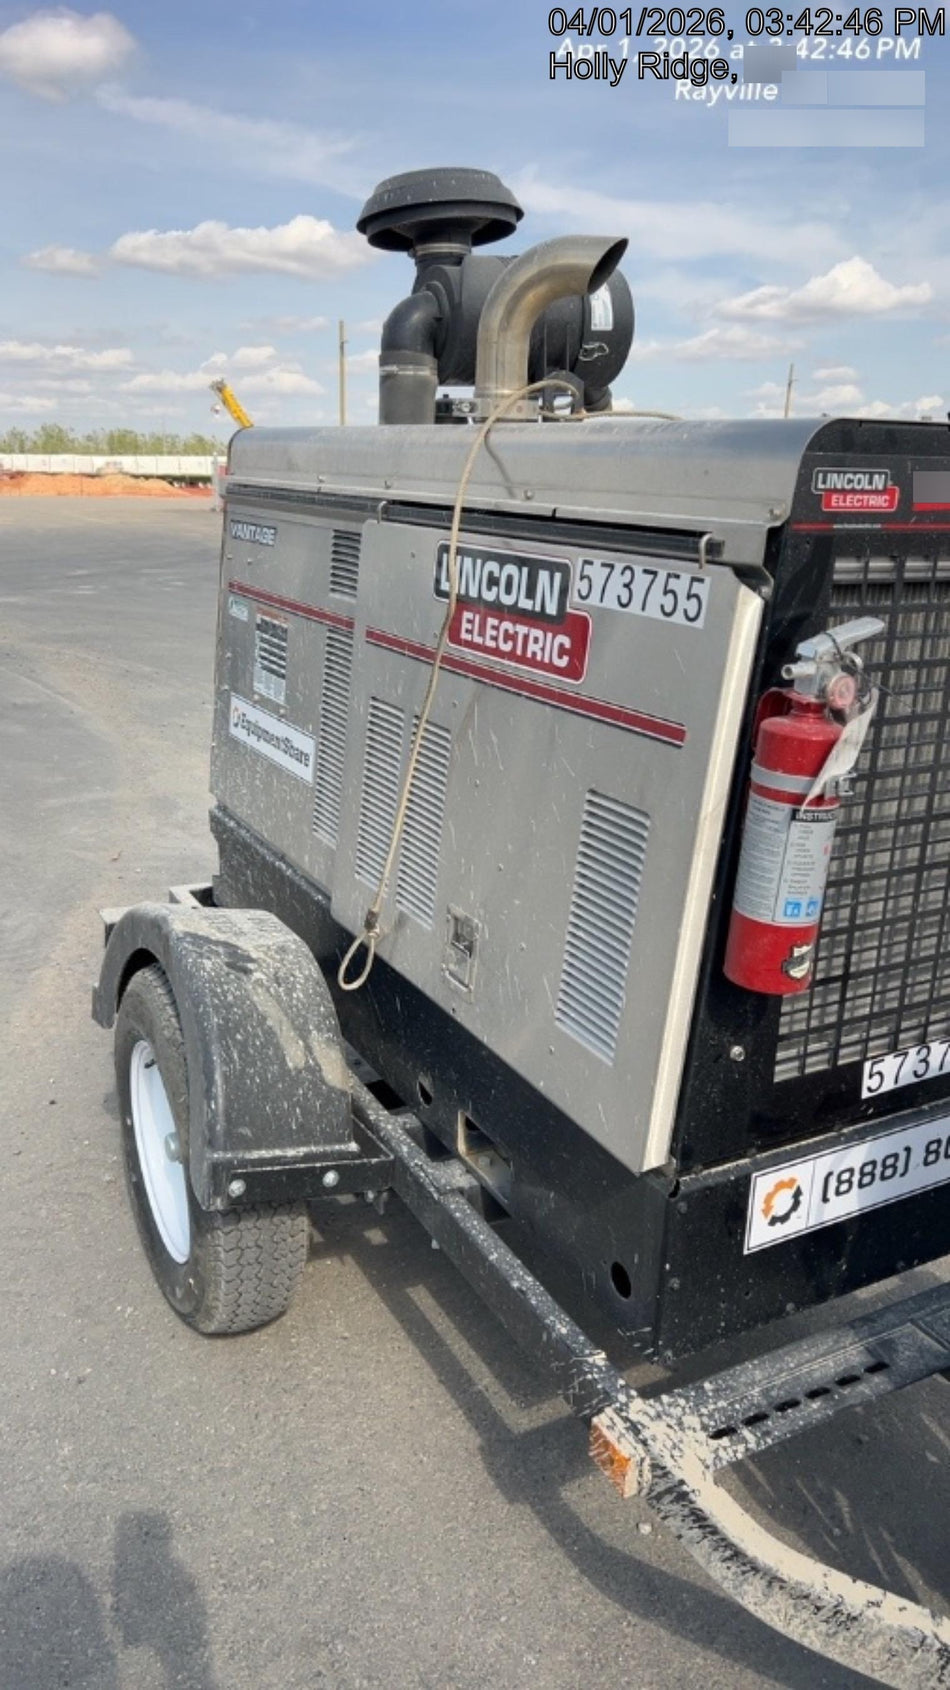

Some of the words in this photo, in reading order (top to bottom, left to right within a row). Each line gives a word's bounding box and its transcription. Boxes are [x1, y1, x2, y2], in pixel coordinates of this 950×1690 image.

[816, 472, 885, 490] LINCOLN
[830, 494, 890, 508] ELECTRIC
[439, 553, 562, 616] LINCOLN
[577, 559, 705, 623] 573755
[460, 610, 571, 668] ELECTRIC
[821, 1145, 912, 1204] (888)
